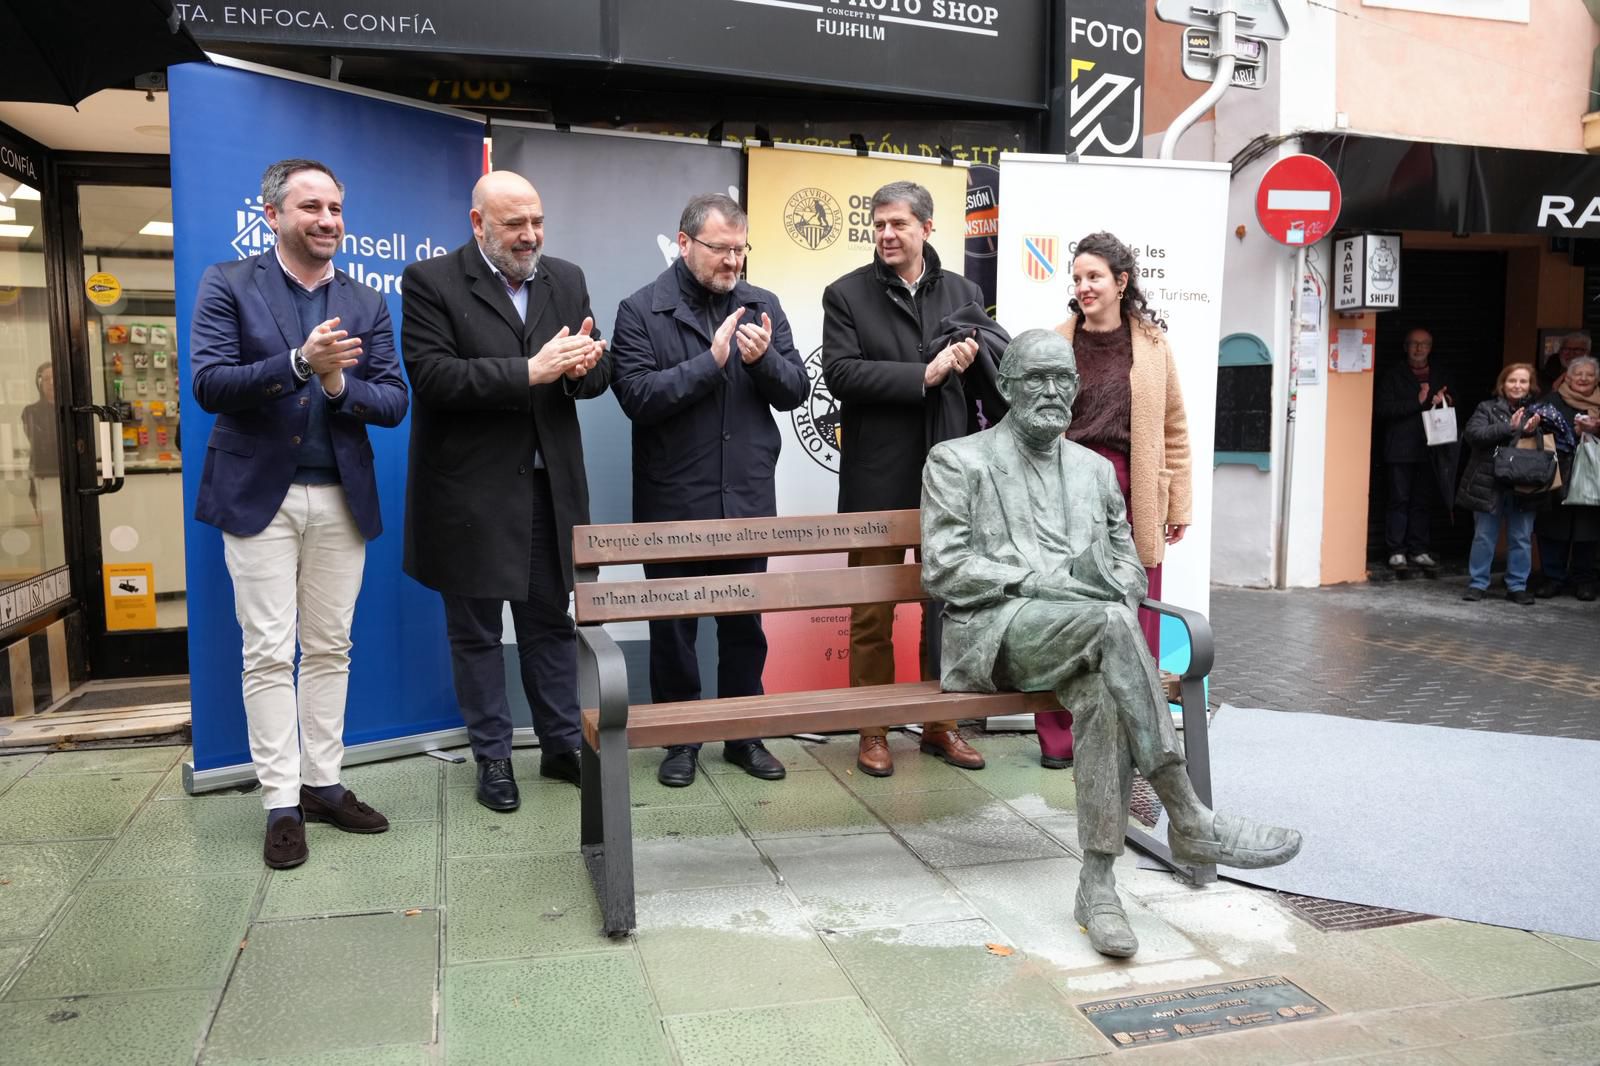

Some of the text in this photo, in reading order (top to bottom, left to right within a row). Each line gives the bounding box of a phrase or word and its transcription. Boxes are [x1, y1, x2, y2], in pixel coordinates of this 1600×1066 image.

[176, 3, 437, 35] TA. ENFOCA. CONFÍA
[826, 7, 876, 20] CONCEPT BY
[932, 0, 999, 26] SHOP
[816, 18, 885, 41] FUJIFILM
[1070, 16, 1143, 55] FOTO
[1234, 67, 1255, 84] ARIZ
[1537, 194, 1600, 229] RA
[341, 233, 406, 261] nsell
[1146, 244, 1166, 258] les
[1343, 241, 1353, 294] RAMEN
[1159, 288, 1211, 303] Turisme,
[1340, 298, 1356, 306] BAR
[1370, 293, 1395, 304] SHIFU
[587, 521, 889, 551] Perquè els mots que altre temps jo no sabia
[592, 584, 756, 606] m'han abocat al poble.
